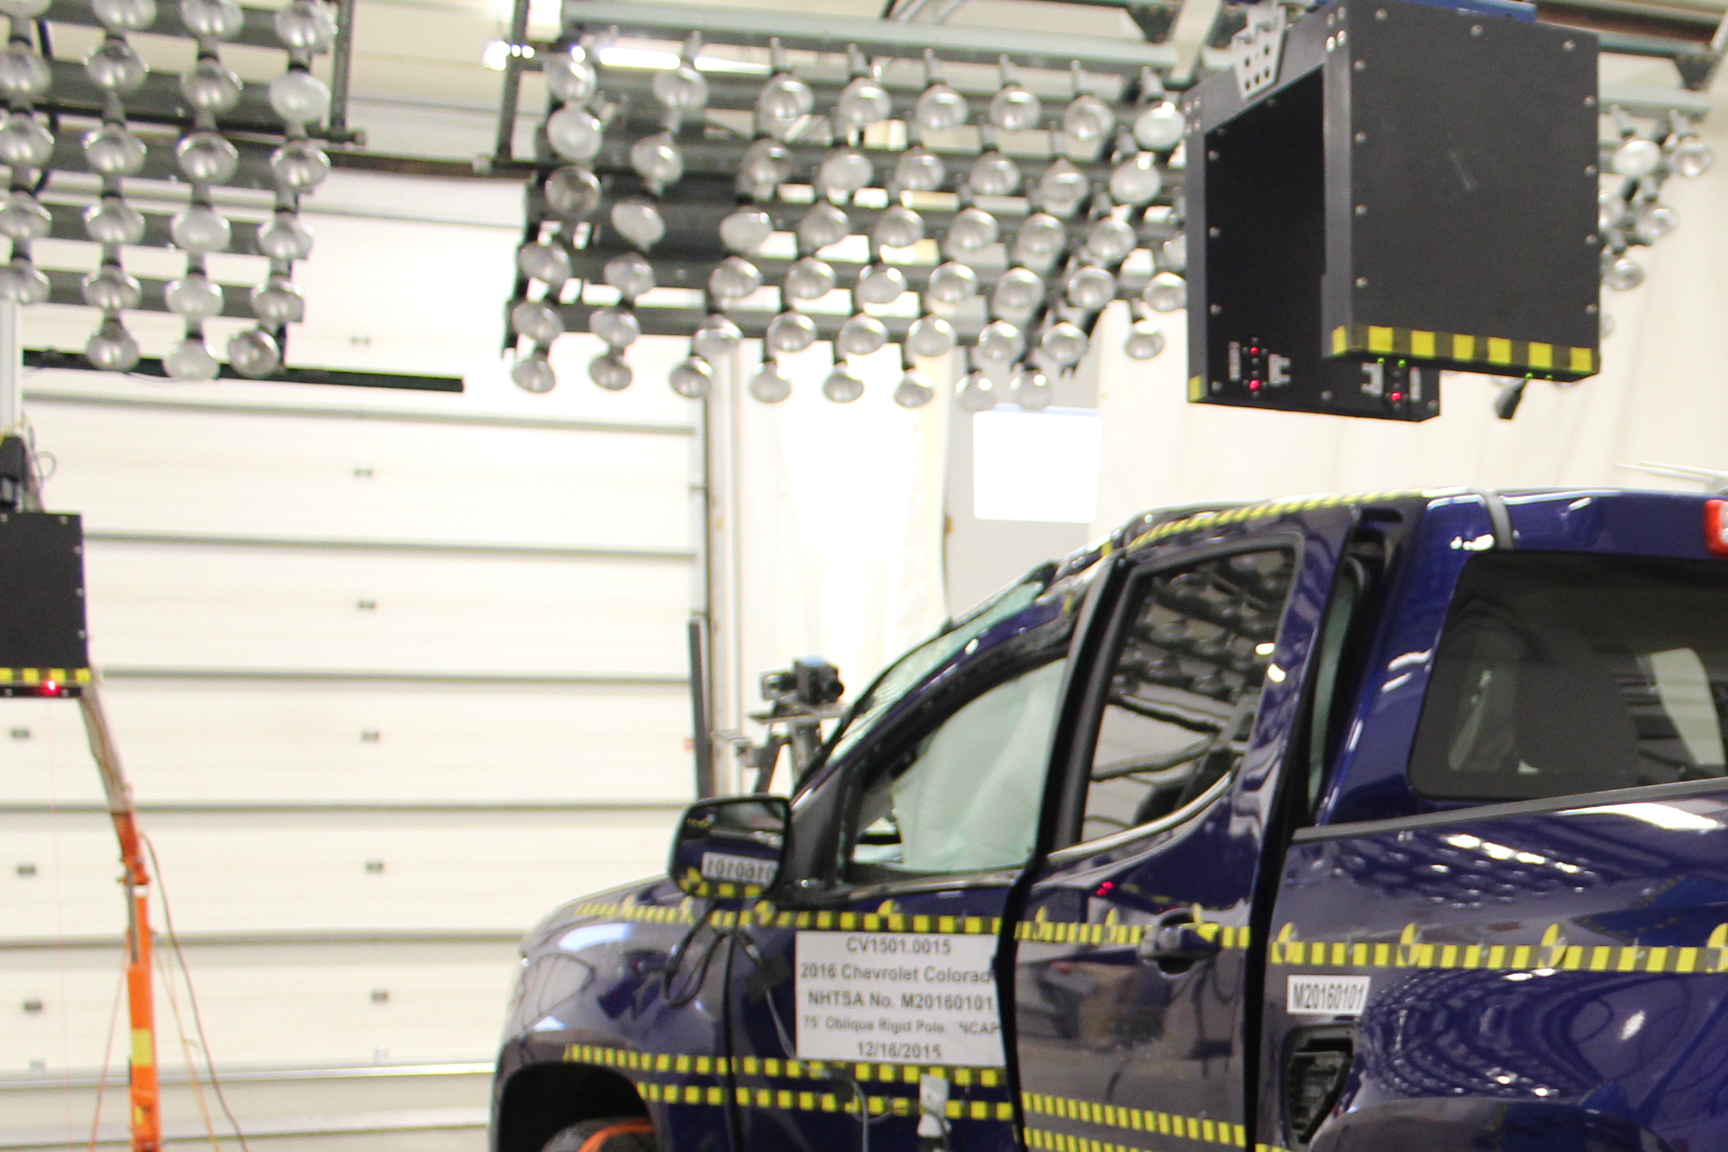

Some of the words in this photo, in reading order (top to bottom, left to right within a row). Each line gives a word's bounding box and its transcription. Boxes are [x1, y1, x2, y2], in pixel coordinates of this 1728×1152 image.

[846, 937, 952, 955] CV1501.0015
[800, 963, 836, 980] 2016
[841, 963, 918, 982] Chevrolet
[923, 966, 996, 984] Colorad
[808, 991, 864, 1007] NHTSA
[870, 993, 896, 1008] No.
[901, 993, 994, 1011] M20160101
[1294, 983, 1364, 1009] M20160101
[825, 1016, 875, 1033] Oblique
[878, 1018, 912, 1035] Rigid
[916, 1020, 945, 1034] Pole
[857, 1041, 942, 1059] 12/16/2015
